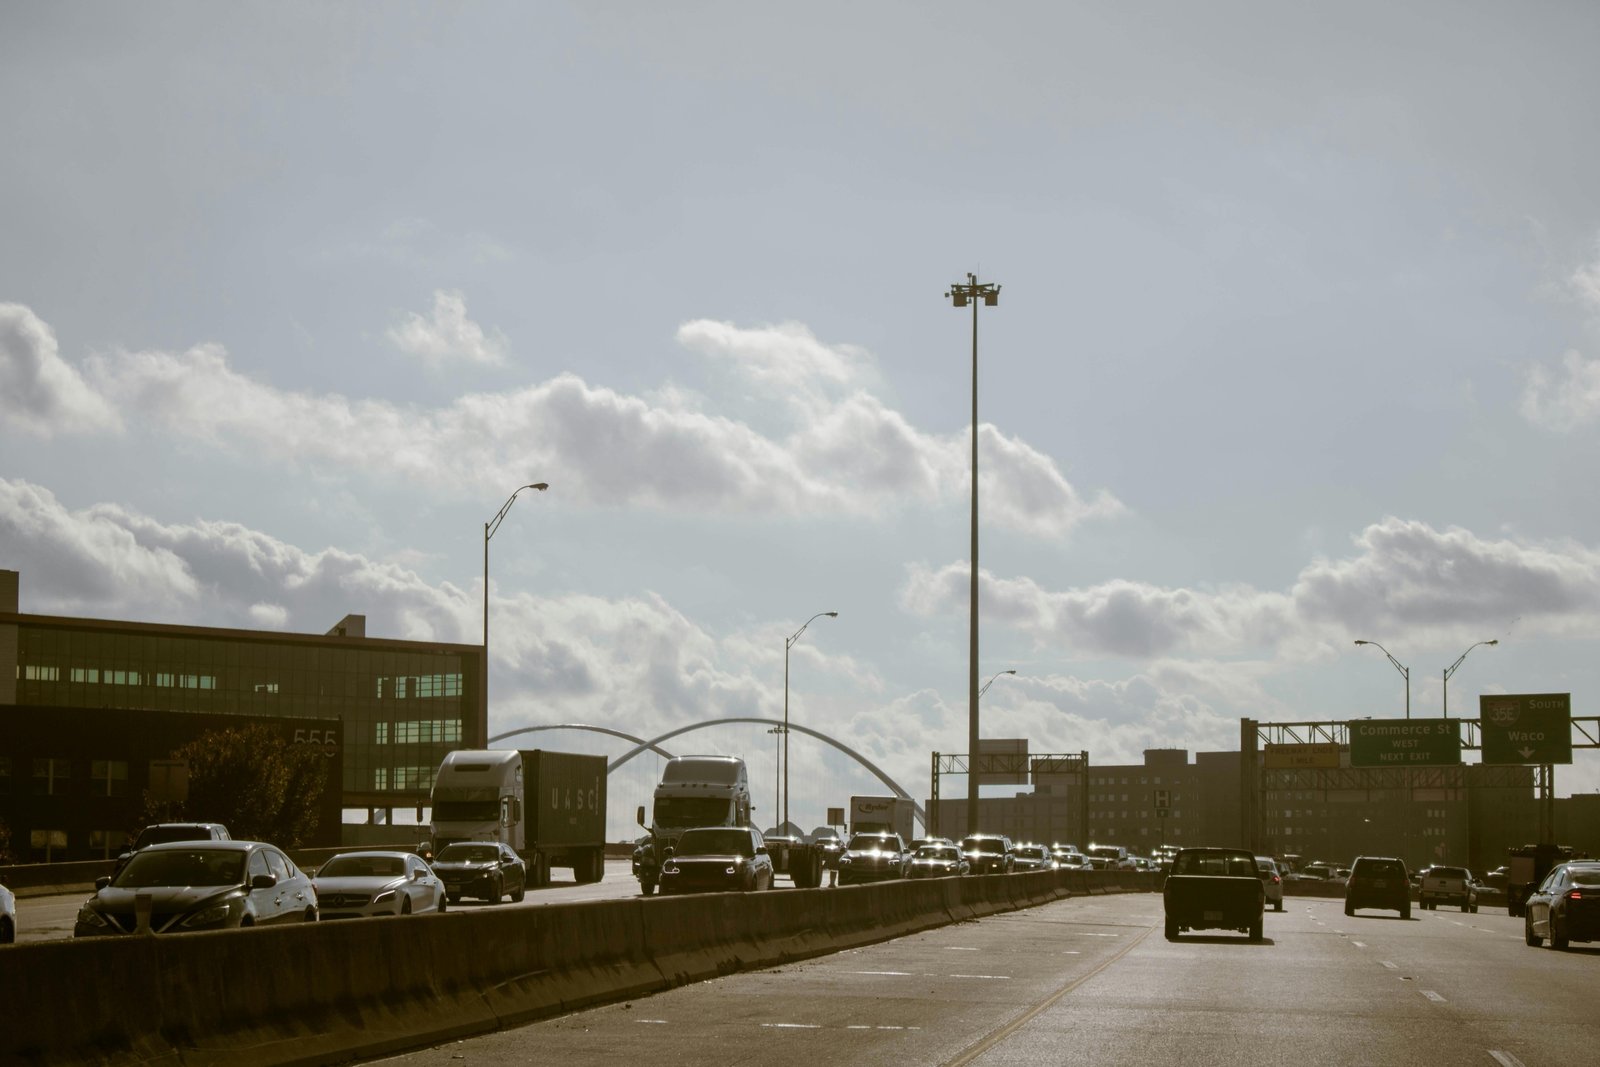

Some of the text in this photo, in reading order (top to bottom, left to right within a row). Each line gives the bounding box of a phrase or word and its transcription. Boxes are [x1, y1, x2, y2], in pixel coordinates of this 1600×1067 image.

[1492, 706, 1514, 721] 35E
[1359, 723, 1451, 736] Commerce St
[1507, 731, 1545, 742] Waco
[294, 729, 337, 758] 555
[1392, 739, 1419, 748] WEST
[1380, 752, 1431, 761] NEXT EXIT
[552, 786, 594, 810] UASC
[1155, 791, 1169, 806] H
[860, 803, 889, 813] Ryder
